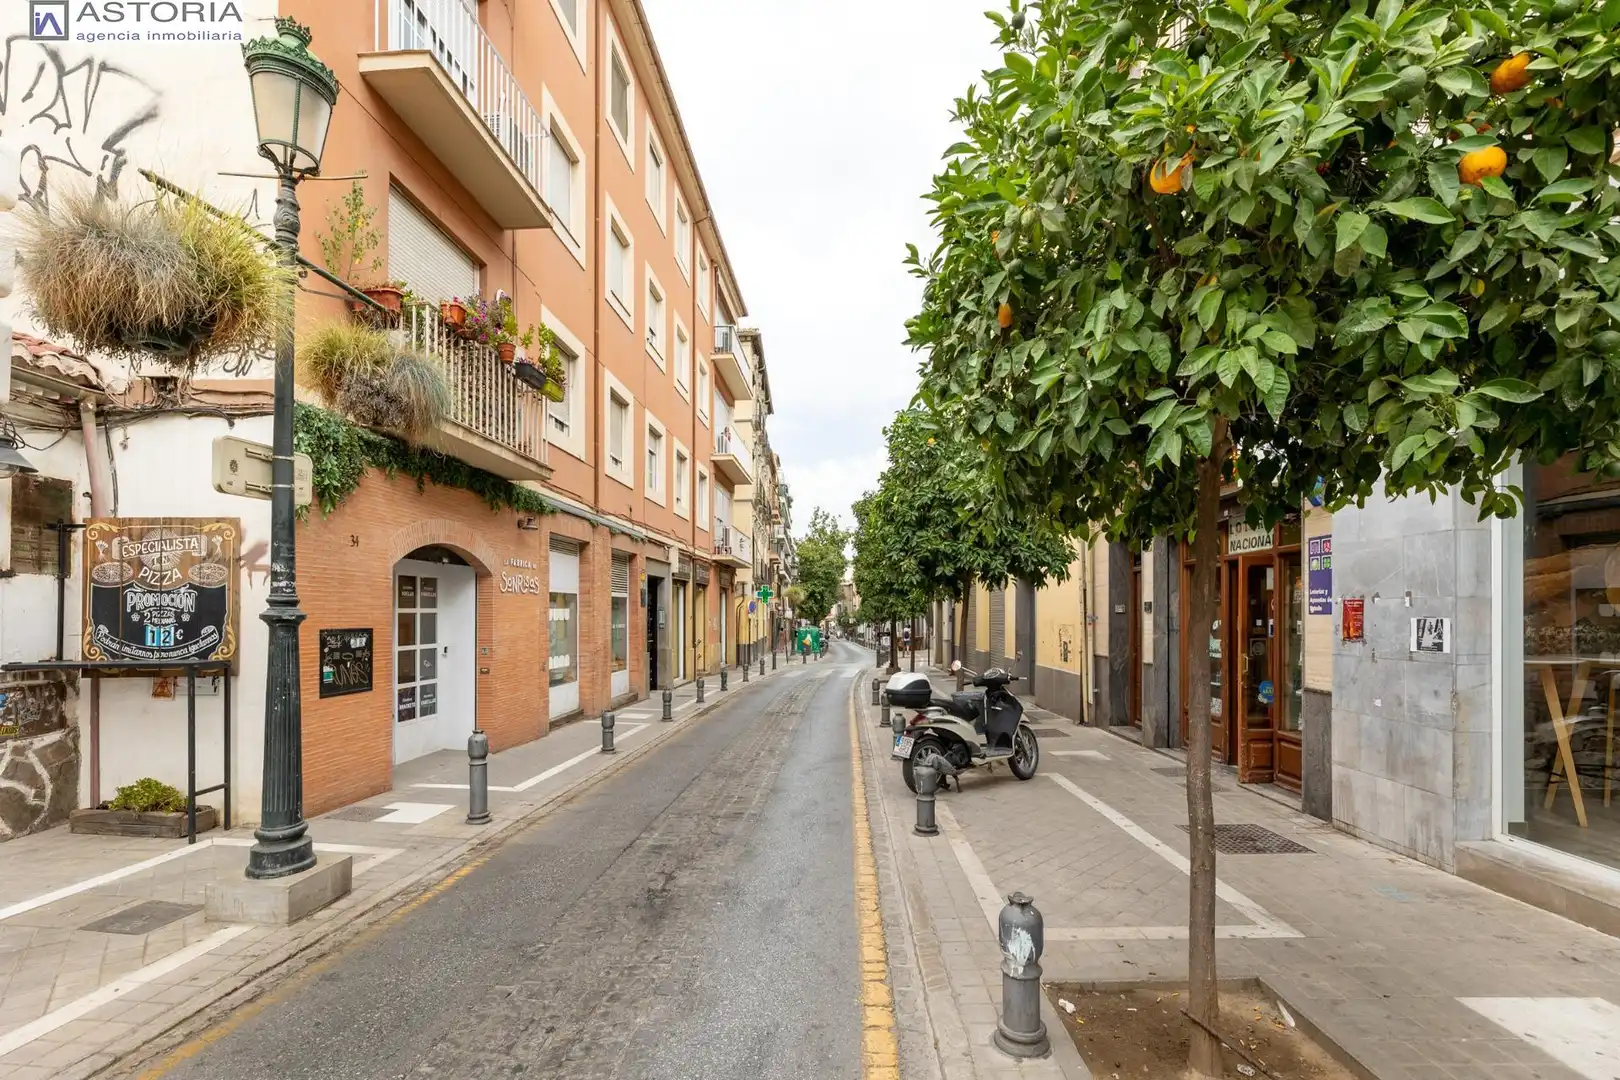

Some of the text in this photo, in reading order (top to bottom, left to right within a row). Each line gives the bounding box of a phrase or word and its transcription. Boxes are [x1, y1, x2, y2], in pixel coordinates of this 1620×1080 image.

[122, 538, 199, 558] ESPECIALISTA
[350, 534, 359, 547] 34
[1230, 534, 1272, 552] NACIONA
[138, 566, 182, 586] PIZZA
[144, 612, 151, 623] 2
